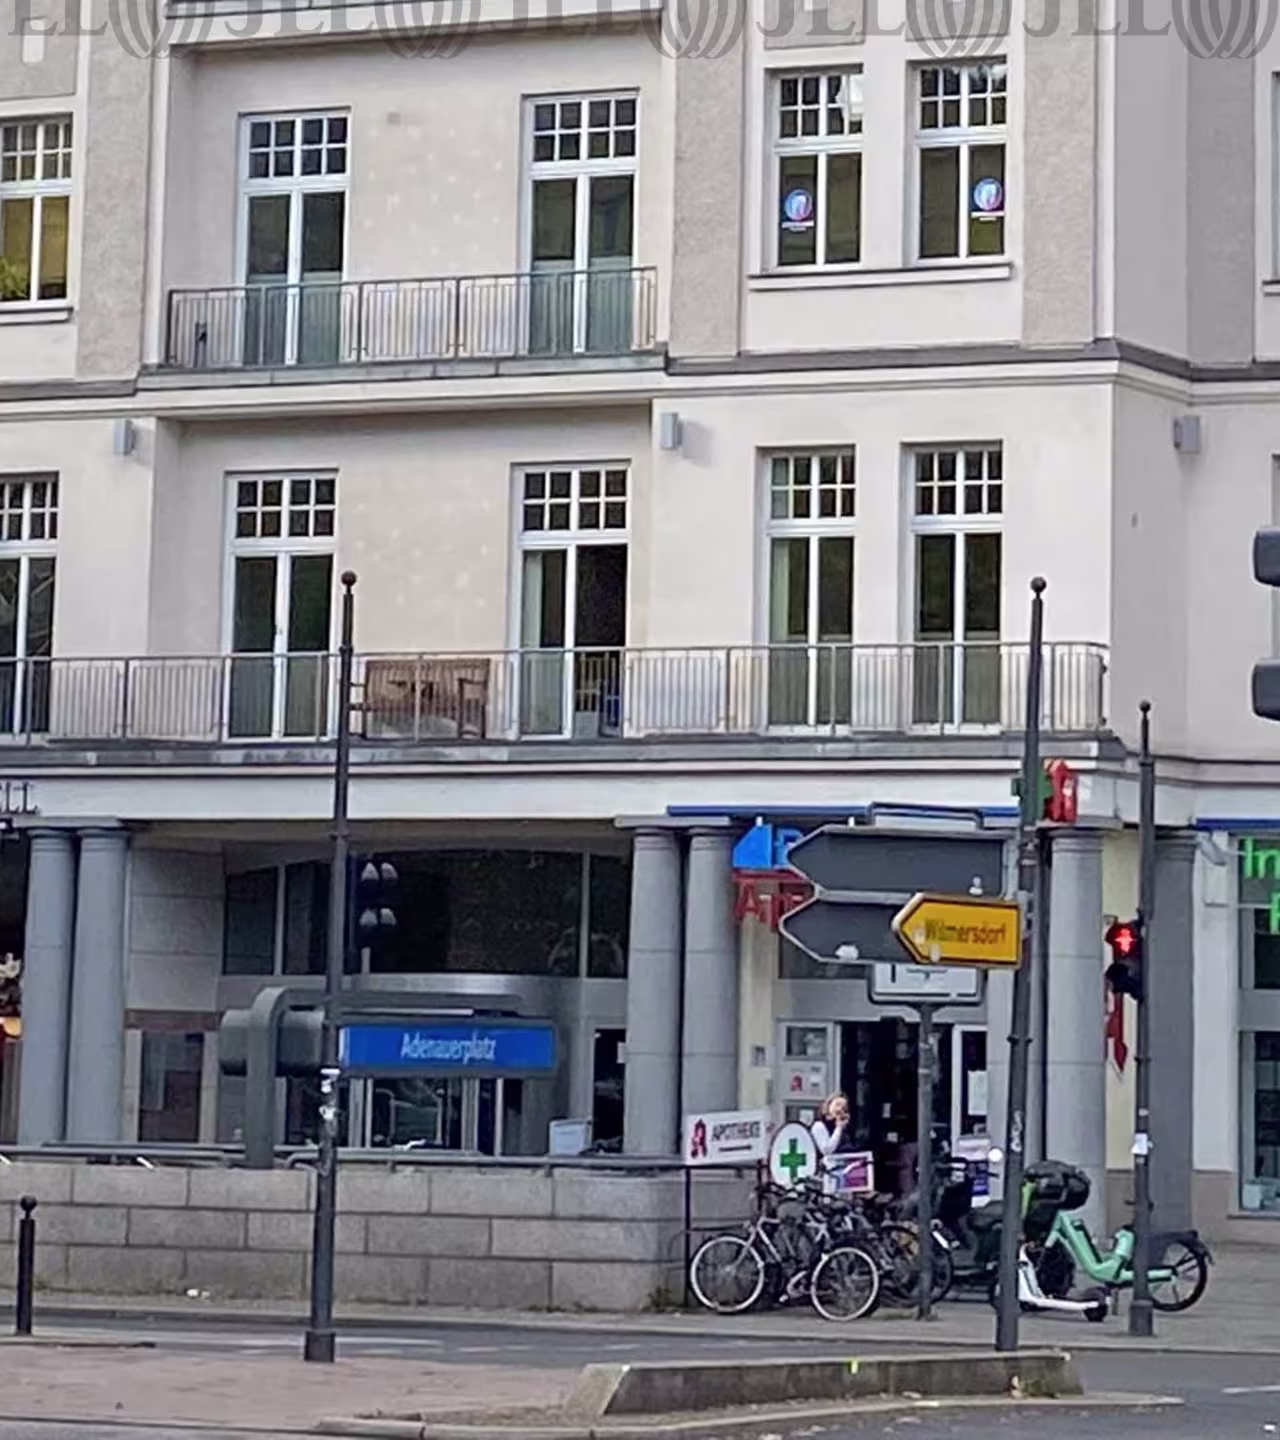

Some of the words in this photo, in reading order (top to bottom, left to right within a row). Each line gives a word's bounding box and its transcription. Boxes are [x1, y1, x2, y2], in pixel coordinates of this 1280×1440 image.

[925, 917, 1007, 945] Wilmersdorf
[400, 1031, 497, 1064] Adenauerplatz
[712, 1121, 761, 1142] APOTHEKE
